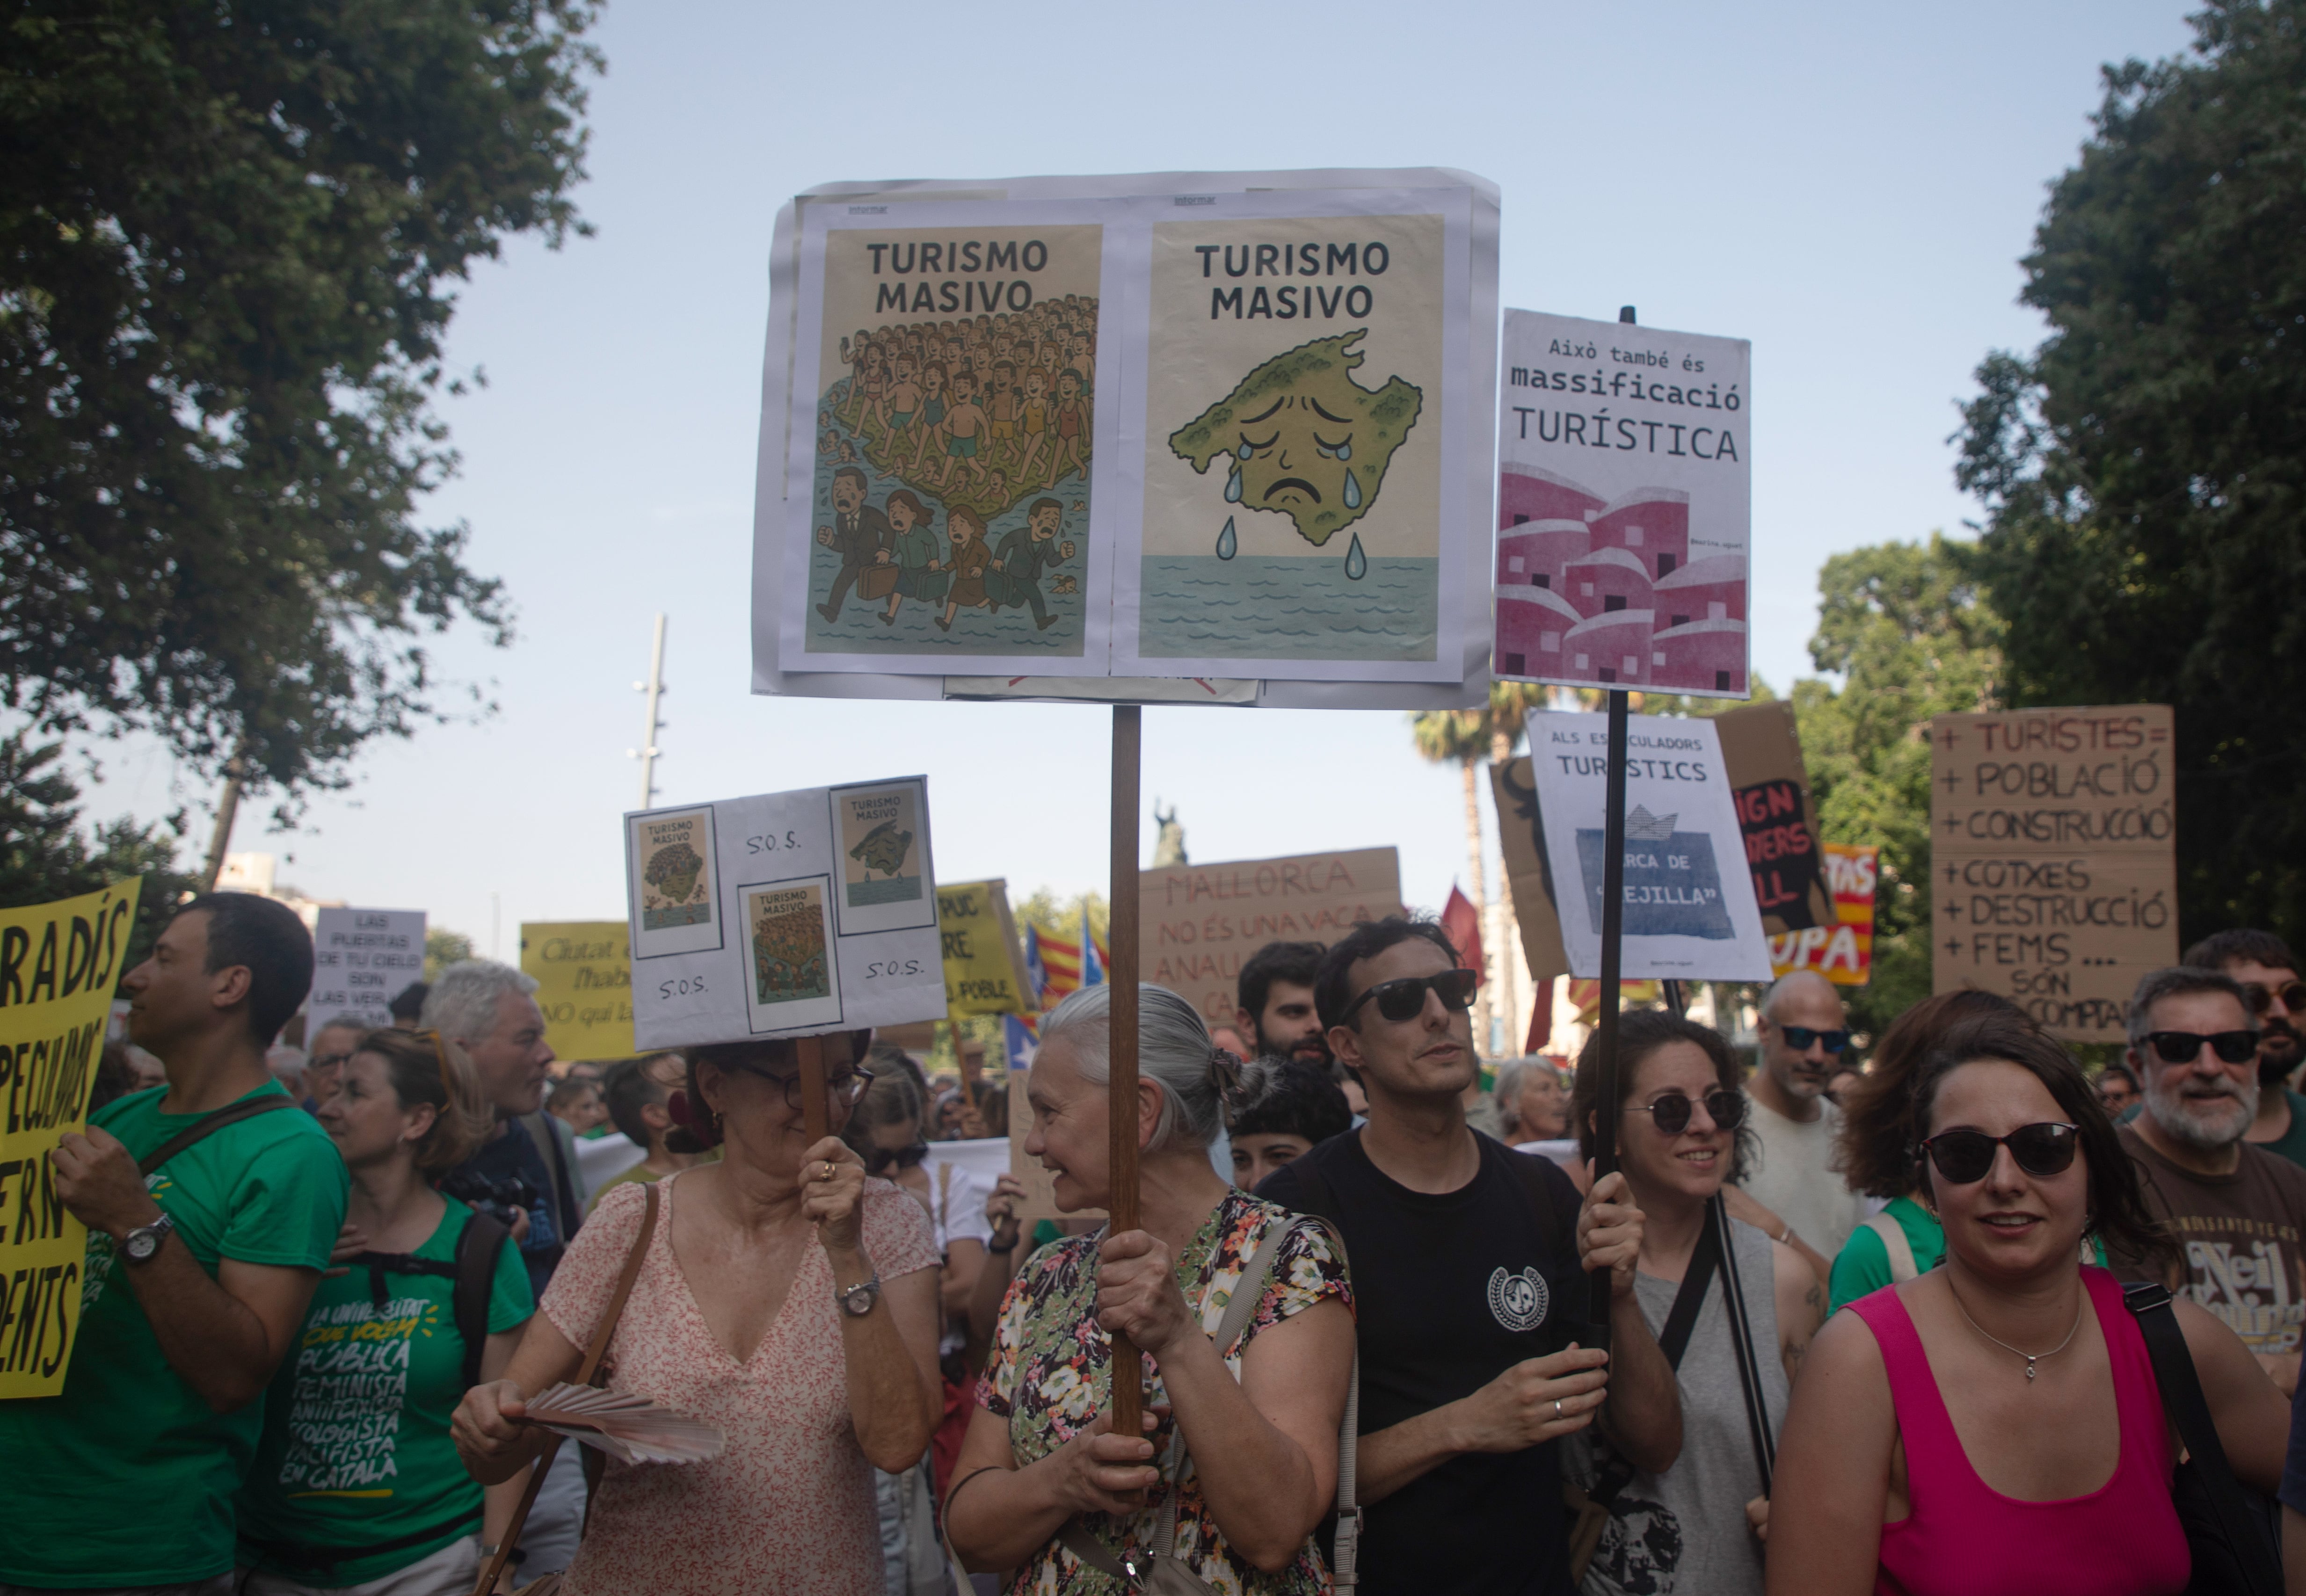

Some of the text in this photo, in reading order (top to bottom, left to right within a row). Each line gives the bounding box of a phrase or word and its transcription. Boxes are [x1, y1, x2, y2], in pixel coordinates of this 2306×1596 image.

[866, 240, 1048, 274] TURISMO
[1195, 242, 1389, 277] TURISMO
[876, 280, 1033, 313] MASIVO
[1211, 285, 1373, 319] MASIVO
[1549, 339, 1704, 372] Això també és
[1511, 366, 1740, 411] massificació
[1512, 406, 1739, 462] TURÍSTICA
[1552, 732, 1702, 750] ALS ESCULADORS
[1557, 755, 1707, 781] TURSTICS
[851, 796, 901, 811] TURISMO
[856, 807, 898, 821] MASIVO
[648, 820, 693, 834] TURISMO
[652, 832, 690, 845] MASIVO
[747, 831, 801, 854] S.O.S.
[1667, 855, 1691, 870] DE
[1963, 860, 2091, 892] COTXES
[1165, 858, 1357, 906] MALLORCA
[1597, 885, 1716, 905] “EJILLA”
[759, 891, 807, 905] TURISMO
[764, 901, 805, 915] MASIVO
[1971, 886, 2168, 929] DESTRUCCIÓ
[1158, 920, 1196, 946] NO
[1240, 911, 1301, 938] UNA
[1302, 904, 1375, 930] VACA
[942, 931, 974, 959] RE
[866, 960, 925, 979] S.O.S.
[2011, 966, 2070, 996] SÓN
[659, 976, 709, 999] S.O.S.
[2185, 1240, 2290, 1310] Neil
[296, 1338, 411, 1376] PÚBLICA
[292, 1370, 407, 1400] FEMINISTA
[286, 1436, 395, 1465] PACIFISTA
[280, 1453, 398, 1489] EN CATALÀ
